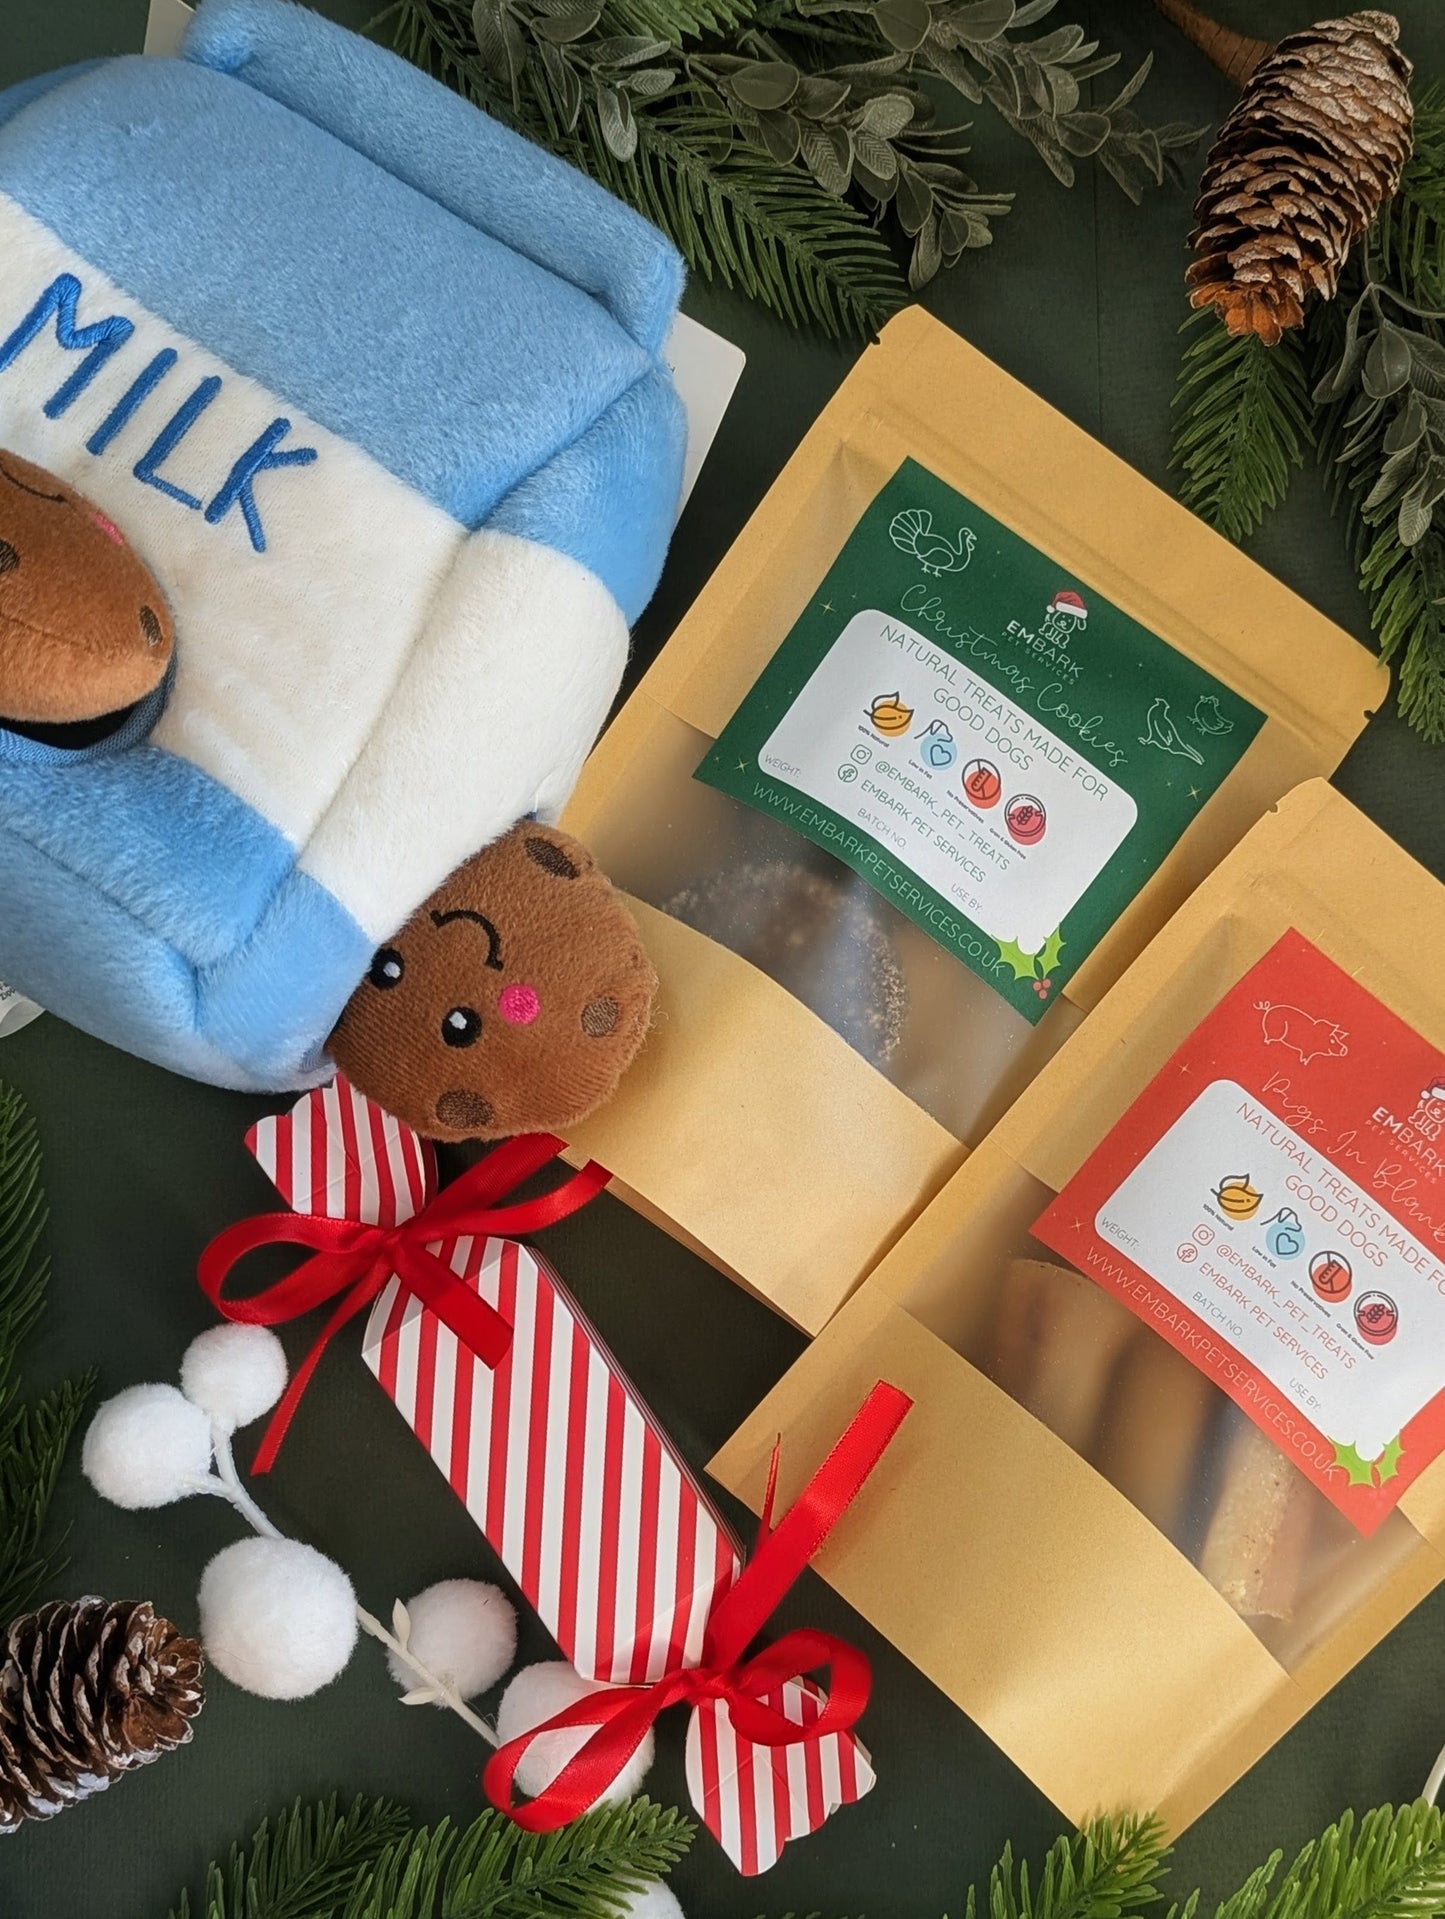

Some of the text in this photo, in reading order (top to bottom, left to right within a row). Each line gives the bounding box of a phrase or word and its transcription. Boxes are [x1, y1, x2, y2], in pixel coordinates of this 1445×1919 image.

[0, 272, 318, 552] MILK
[900, 584, 1128, 767] Christmas Cookies
[1006, 620, 1084, 678] EMBARK
[880, 625, 1108, 802] NATURAL TREATS MADE FOR
[933, 688, 1034, 770] GOOD DOGS
[764, 754, 802, 777] WEIGHT:
[857, 807, 908, 849] BATCH NO.
[861, 779, 986, 883] EMBARK PET SERVICES
[753, 782, 1006, 978] WWW.EMBARKPETSERVICES.CO.UK
[951, 883, 984, 913] USE BY:
[1261, 1071, 1328, 1134] Pigs
[1327, 1130, 1366, 1164] In
[1372, 1106, 1445, 1177] EMBARK
[1101, 1217, 1140, 1251] WEIGHT:
[1236, 1102, 1315, 1174] NATURAL
[1317, 1168, 1381, 1229] TREATS
[1378, 1224, 1431, 1274] MADE
[1284, 1175, 1389, 1267] GOOD DOGS
[1192, 1291, 1243, 1338] BATCH NO.
[1199, 1262, 1328, 1381] EMBARK PET SERVICES
[1086, 1246, 1340, 1482] WWW.EMBARKPETSERVICES.CO.UK
[1289, 1378, 1322, 1412] USE BY:
